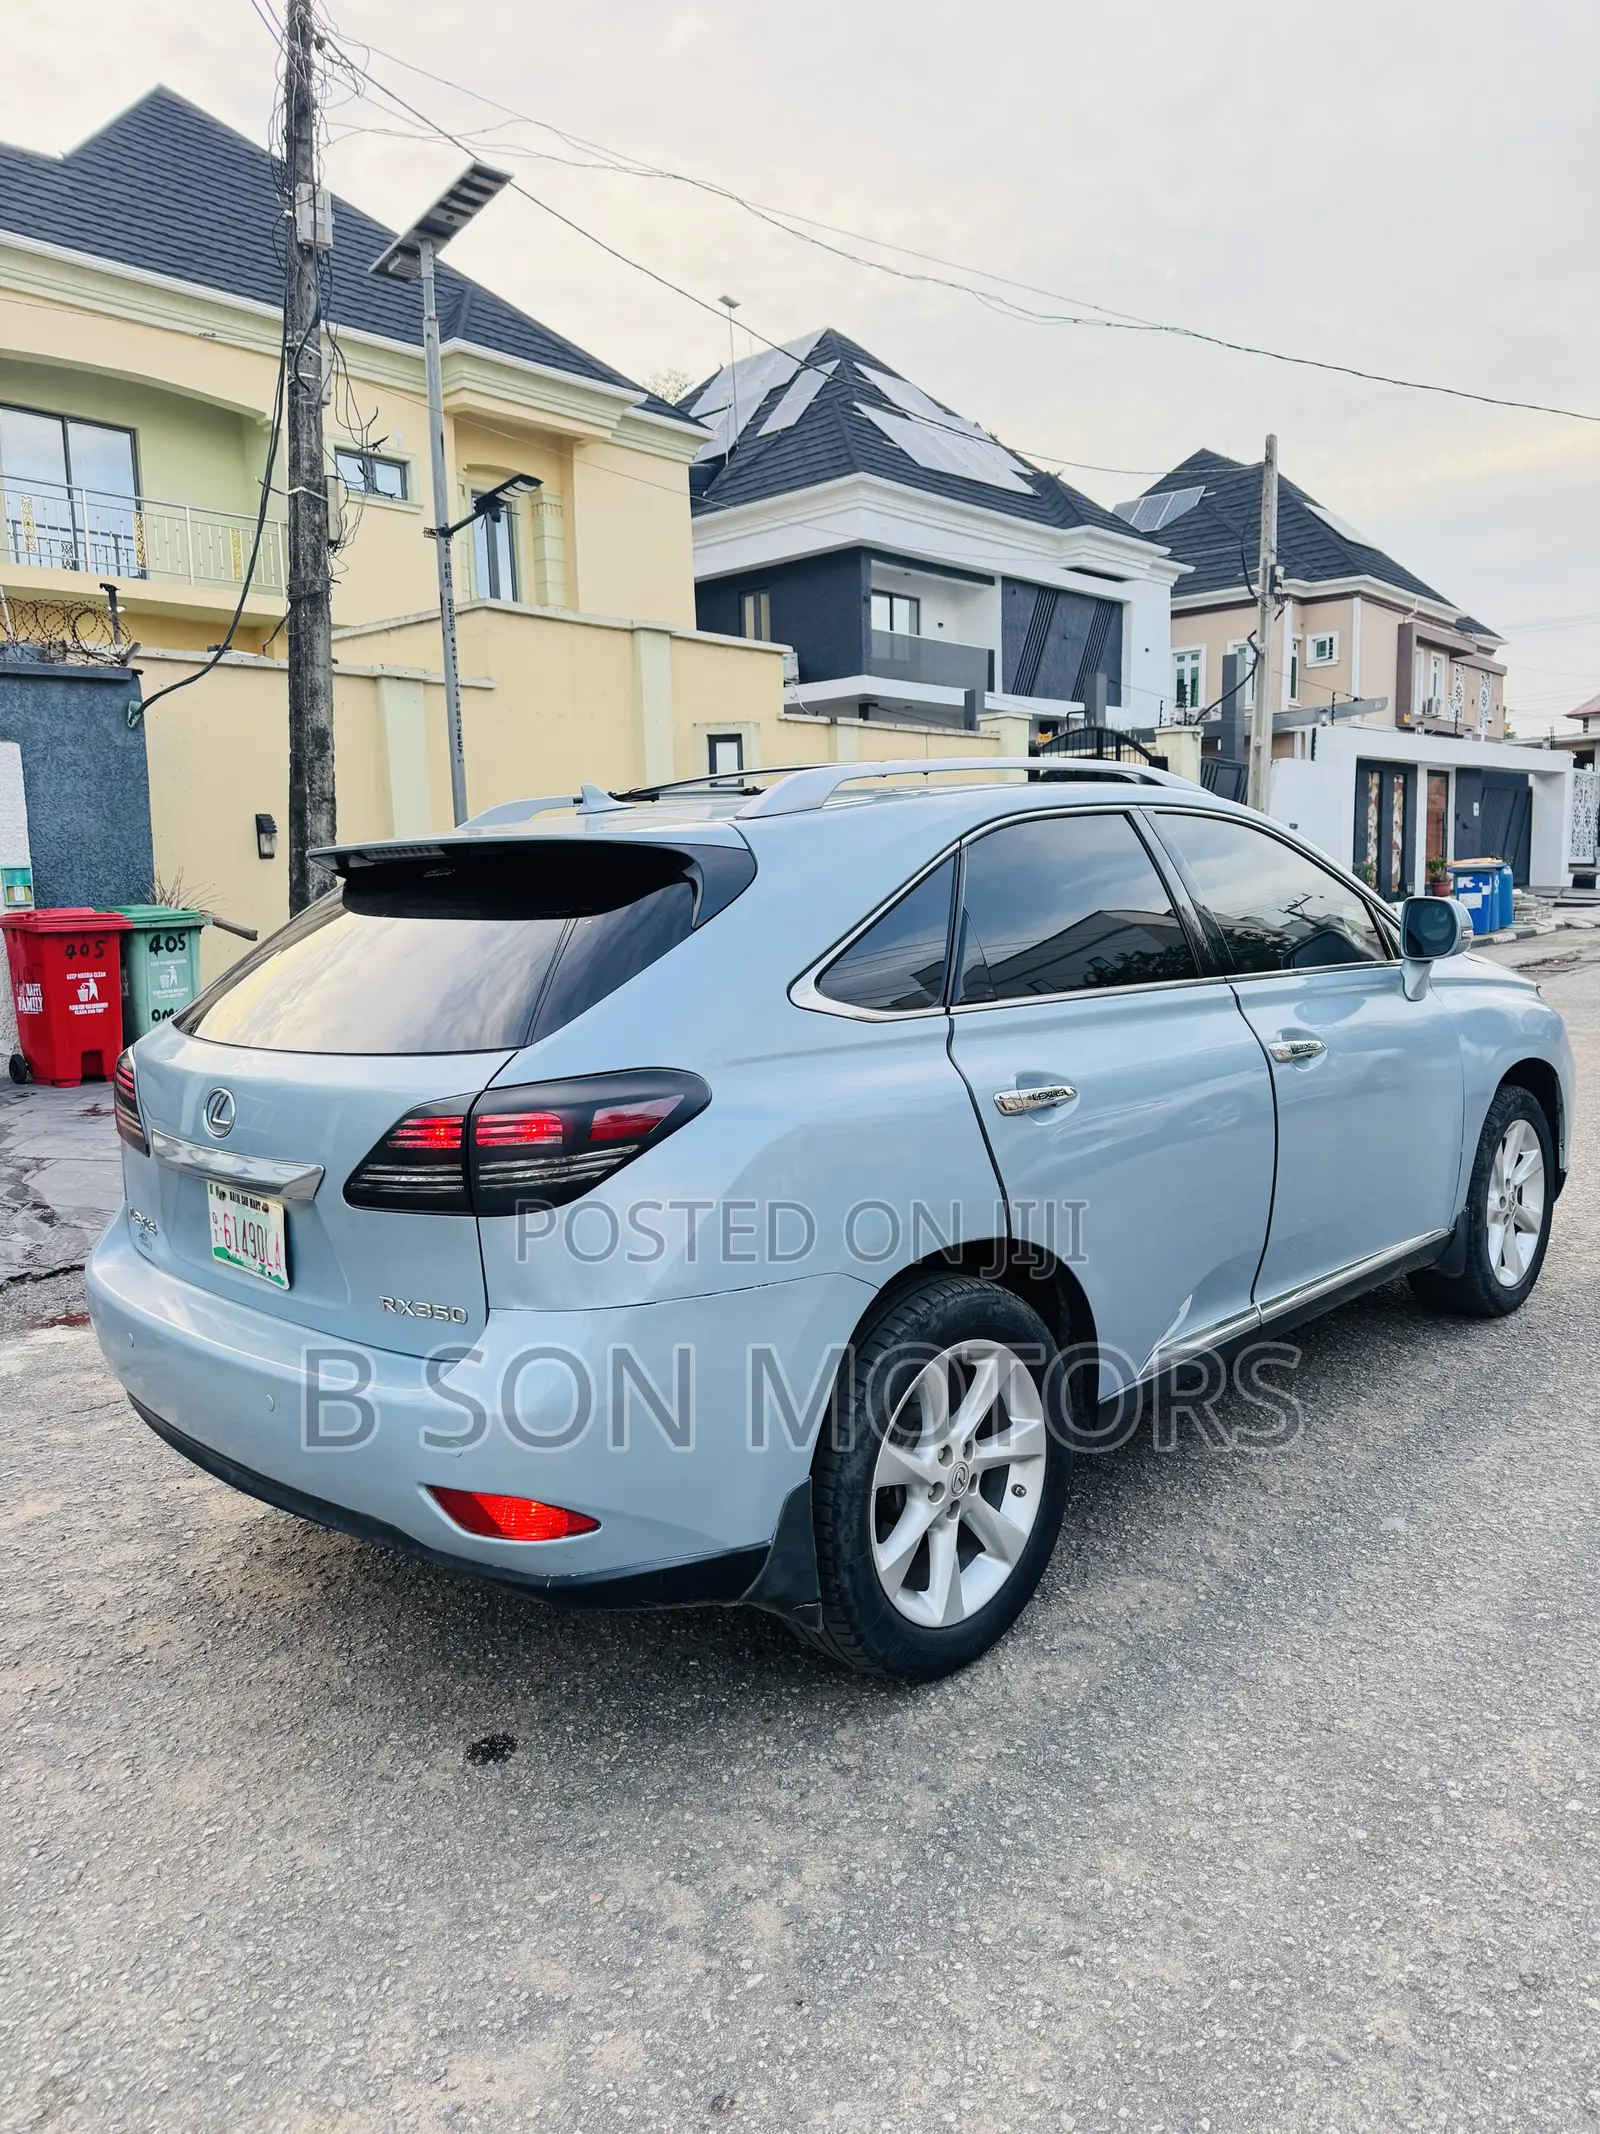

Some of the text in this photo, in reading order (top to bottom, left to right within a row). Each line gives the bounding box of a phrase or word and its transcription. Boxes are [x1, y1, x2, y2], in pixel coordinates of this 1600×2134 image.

[65, 940, 106, 960] 405
[148, 932, 187, 957] 405
[379, 1295, 468, 1324] RX350
